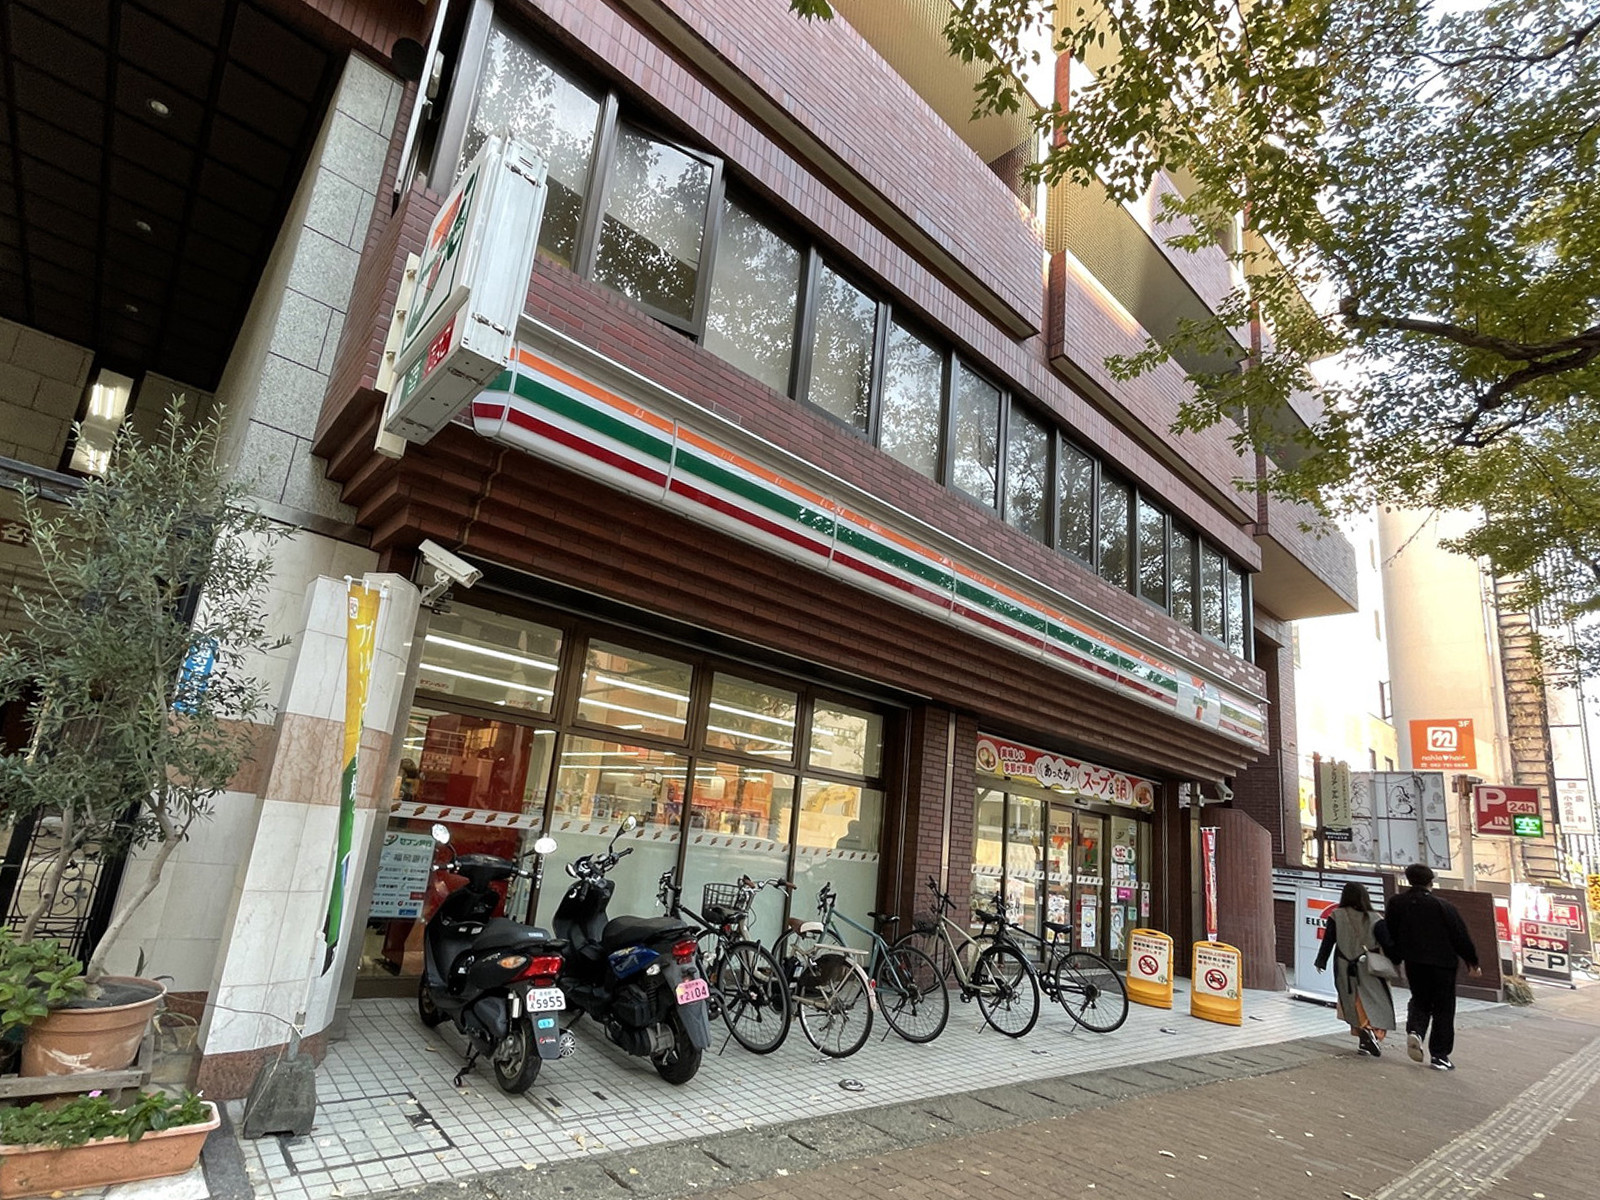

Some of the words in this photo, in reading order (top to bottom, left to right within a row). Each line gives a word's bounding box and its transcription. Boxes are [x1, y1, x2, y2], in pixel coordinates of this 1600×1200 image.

[1000, 746, 1026, 761] 美味しい
[1044, 763, 1071, 782] あったか
[1479, 788, 1507, 812] P
[1509, 802, 1534, 812] 24h
[1494, 816, 1509, 825] IN
[1514, 817, 1541, 834] 空
[1306, 917, 1327, 927] ELEV
[1525, 937, 1564, 951] やまや
[1547, 954, 1566, 969] P
[536, 996, 563, 1009] 5955
